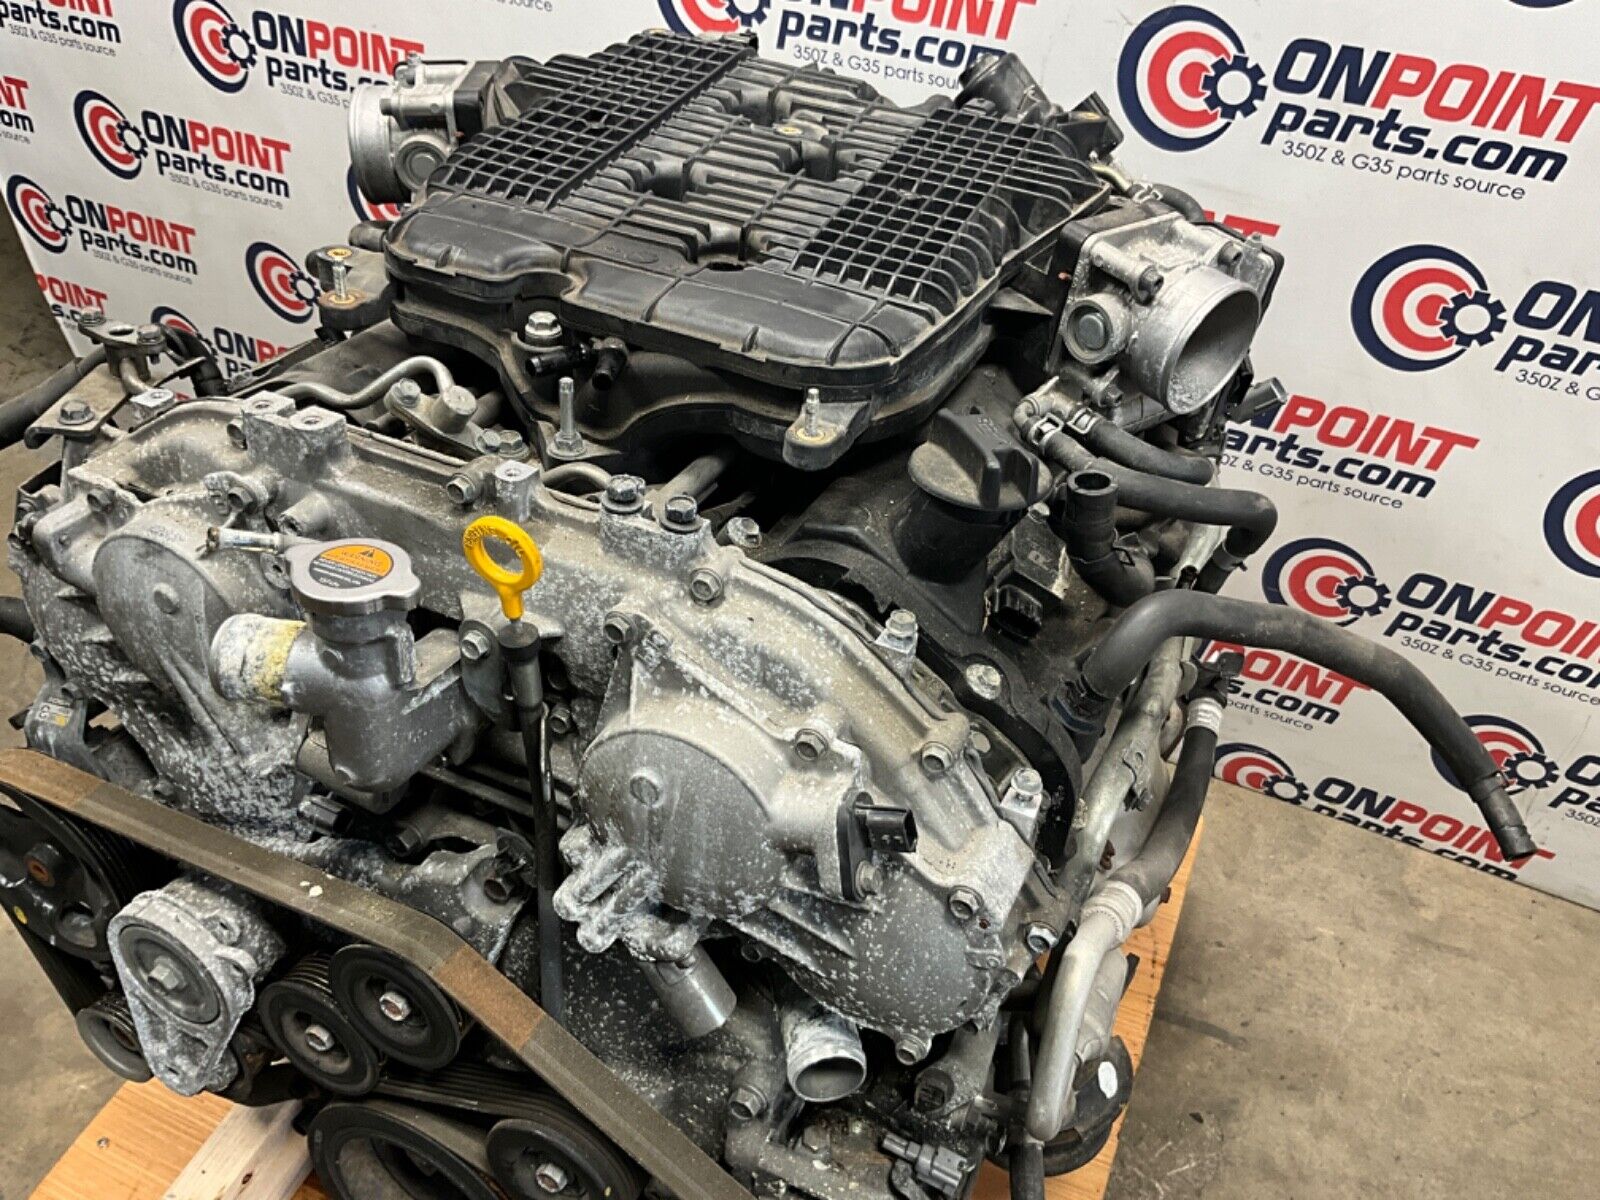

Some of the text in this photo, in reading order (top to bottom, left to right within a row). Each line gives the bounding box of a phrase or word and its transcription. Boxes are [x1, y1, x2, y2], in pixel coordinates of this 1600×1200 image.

[0, 0, 121, 43] parts.com
[794, 44, 827, 64] 350Z
[833, 51, 844, 67] &
[848, 55, 880, 74] G35
[884, 65, 924, 84] parts
[1272, 37, 1600, 144] ONPOINT
[141, 110, 291, 174] ONPOINT
[1261, 102, 1568, 183] parts.com
[155, 149, 290, 198] parts.com
[1281, 141, 1526, 201] 350Z & G35 parts source
[65, 195, 196, 254] ONPOINT
[79, 229, 198, 275] parts.com
[1515, 369, 1562, 391] 350Z
[1564, 381, 1580, 396] &
[1242, 460, 1253, 473] &
[1259, 463, 1294, 481] G35
[1296, 475, 1340, 494] parts
[1344, 486, 1403, 508] source
[1401, 636, 1600, 705] 350Z & G35 parts source
[1264, 710, 1313, 730] source
